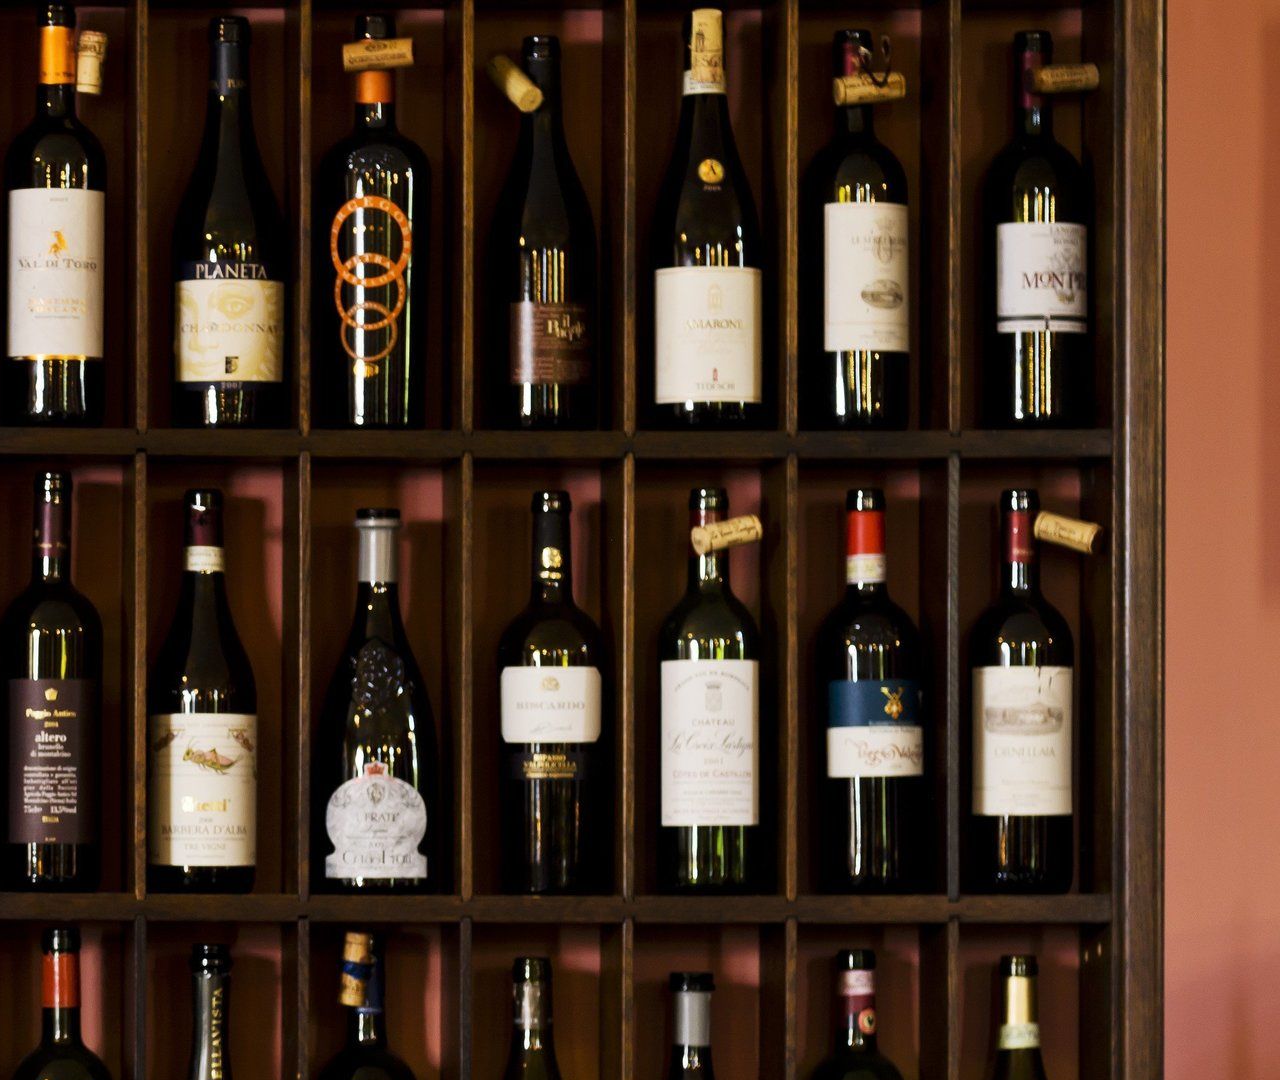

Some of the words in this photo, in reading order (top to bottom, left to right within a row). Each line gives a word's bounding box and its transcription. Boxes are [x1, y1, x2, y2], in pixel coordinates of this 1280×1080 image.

[42, 258, 56, 270] DI
[195, 263, 268, 281] PLANETA
[515, 701, 586, 711] BISCARDO
[34, 732, 68, 744] altero
[160, 824, 210, 836] BARBERA
[212, 824, 248, 835] D'ALBA
